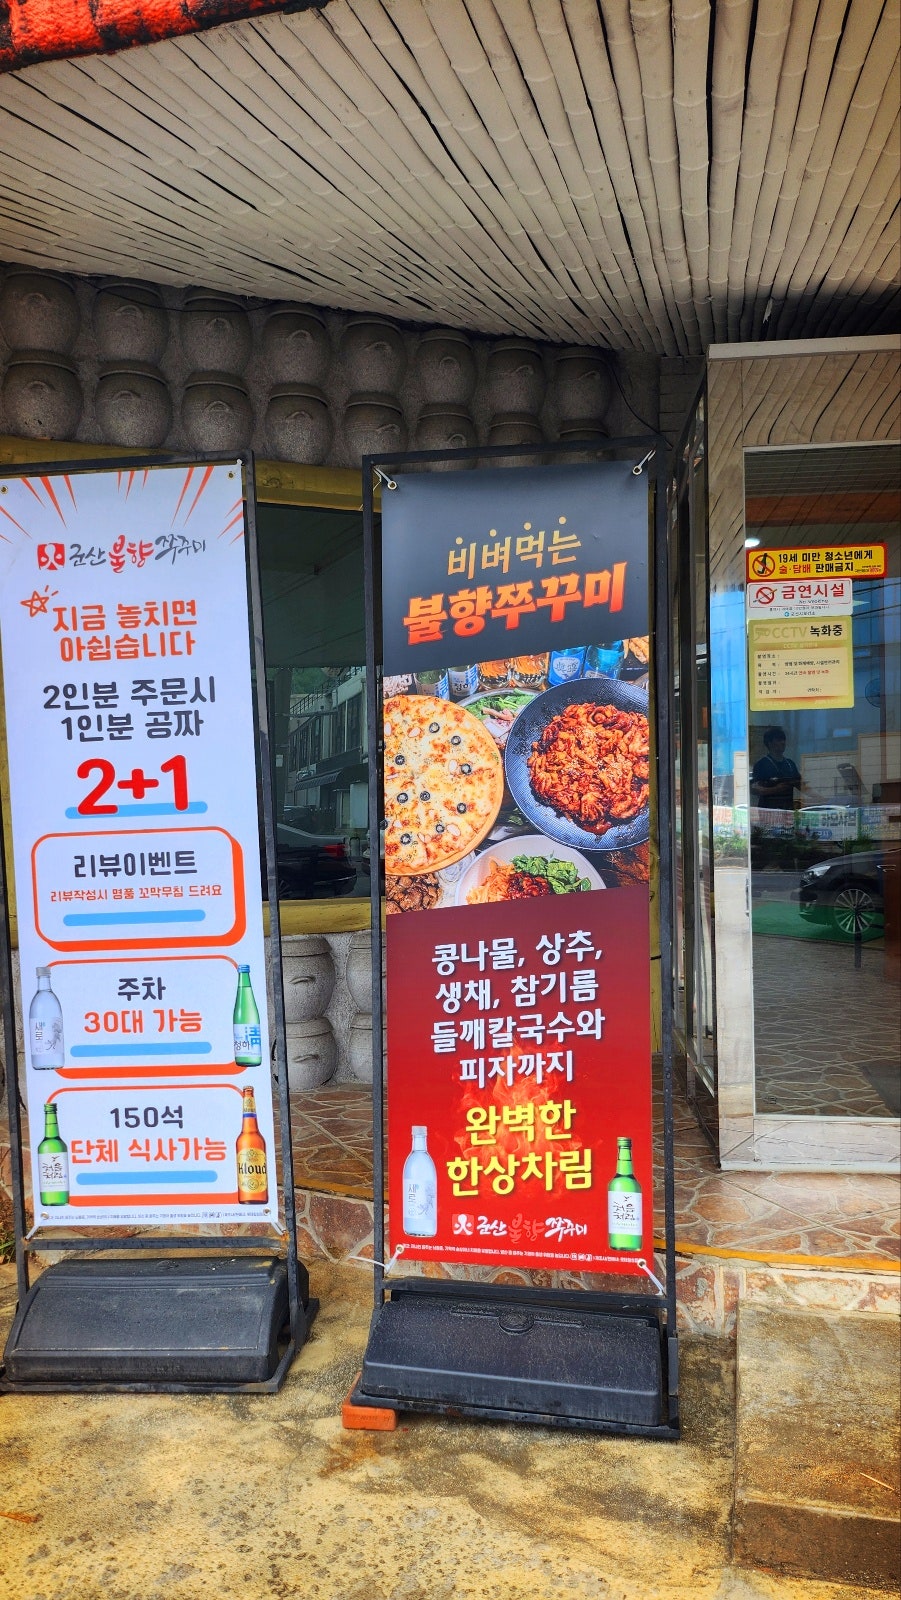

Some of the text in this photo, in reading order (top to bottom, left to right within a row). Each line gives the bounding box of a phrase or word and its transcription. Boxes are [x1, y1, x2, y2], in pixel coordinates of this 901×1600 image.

[447, 517, 583, 581] 비벼먹는
[779, 550, 873, 563] 19세 미만 청소년에게
[815, 562, 854, 573] 판매금지
[402, 561, 628, 646] 불향쭈꾸미
[781, 583, 845, 600] 금연시설
[53, 599, 198, 632] 지금 놓치면
[772, 624, 843, 639] CCTV 녹화중
[60, 631, 197, 662] 아쉽습니다
[43, 675, 216, 710] 2인분 주문시
[61, 710, 204, 743] 1인분 공짜
[77, 755, 190, 815] 2+1
[74, 850, 198, 878] 리뷰이벤트
[50, 888, 108, 903] 리뷰작성시
[138, 886, 184, 900] 꼬막무침
[188, 885, 223, 898] 드려요
[432, 930, 603, 976] 콩나물, 상추,
[117, 977, 166, 1002] 주차
[435, 969, 599, 1014] 생채, 참기름
[84, 1007, 203, 1034] 30대 가능
[431, 1008, 605, 1054] 들깨칼국수와
[459, 1050, 574, 1089] 피자까지
[110, 1105, 185, 1130] 150석
[465, 1099, 577, 1147] 완벽한
[70, 1136, 228, 1164] 단체 식사가능
[446, 1150, 593, 1198] 한상차림
